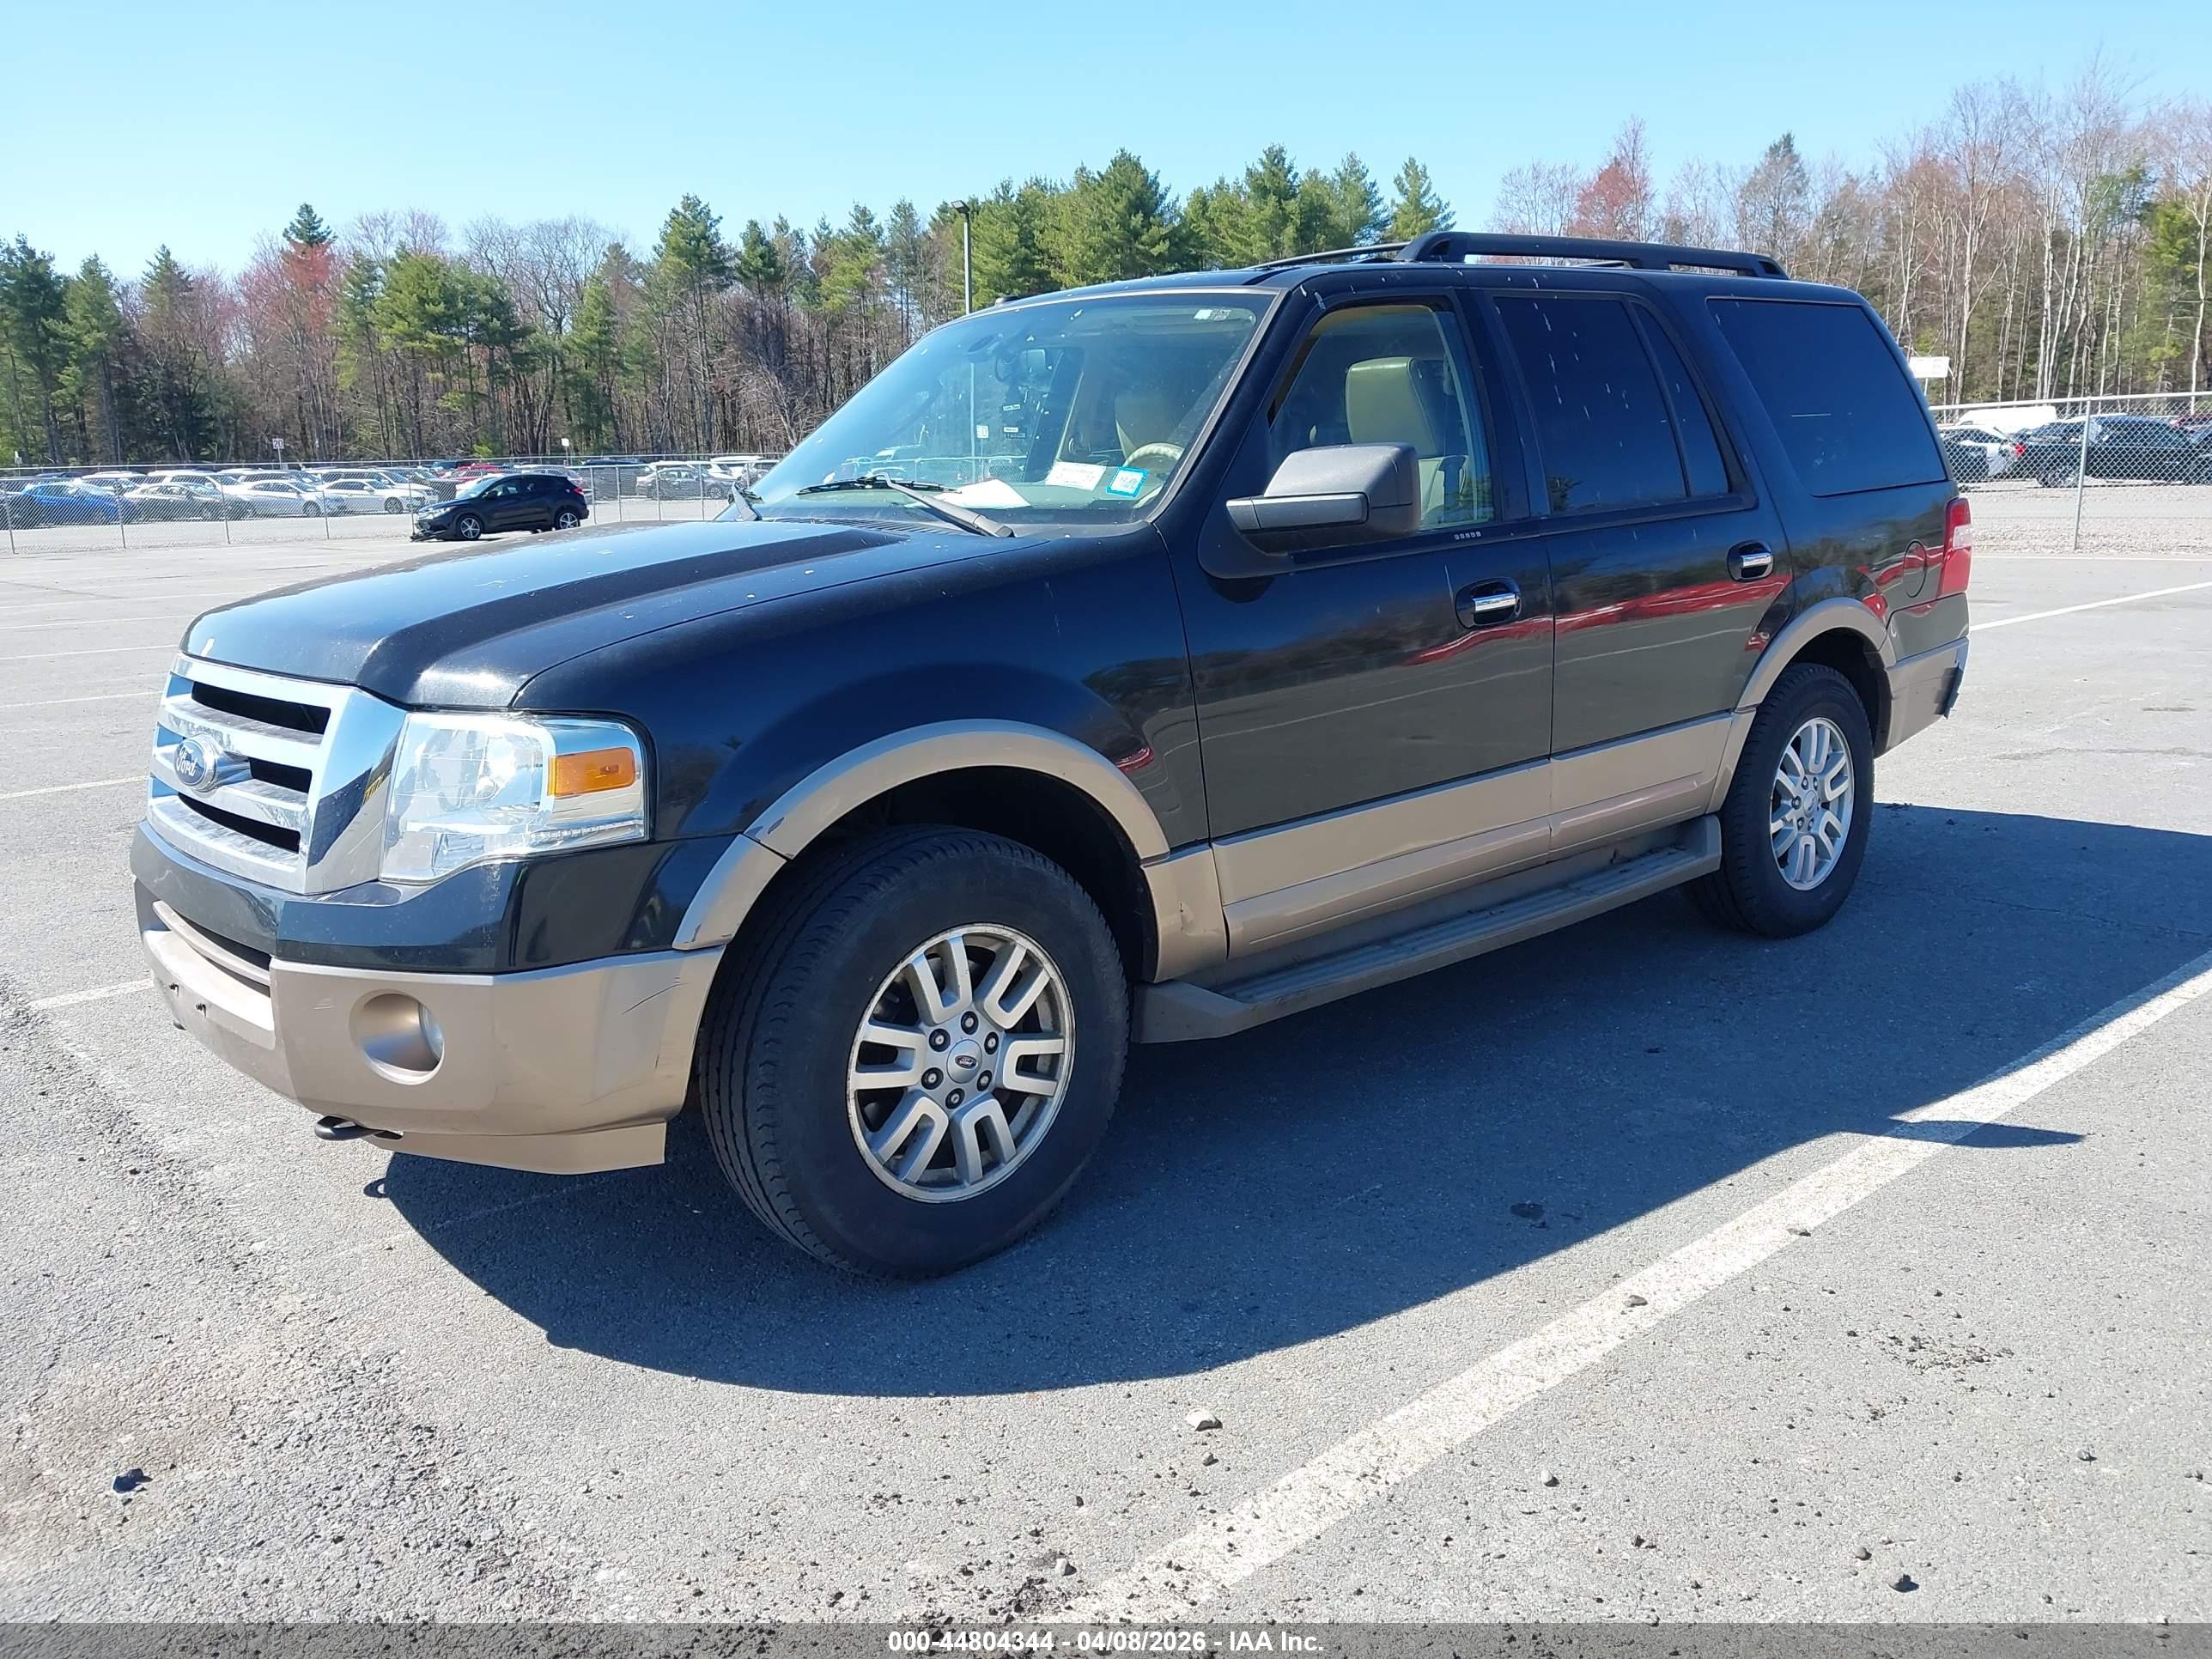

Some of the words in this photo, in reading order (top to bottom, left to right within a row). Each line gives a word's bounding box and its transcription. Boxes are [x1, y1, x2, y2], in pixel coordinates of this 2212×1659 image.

[273, 439, 283, 448] 20
[175, 744, 198, 777] Ford
[957, 1057, 974, 1067] Ford
